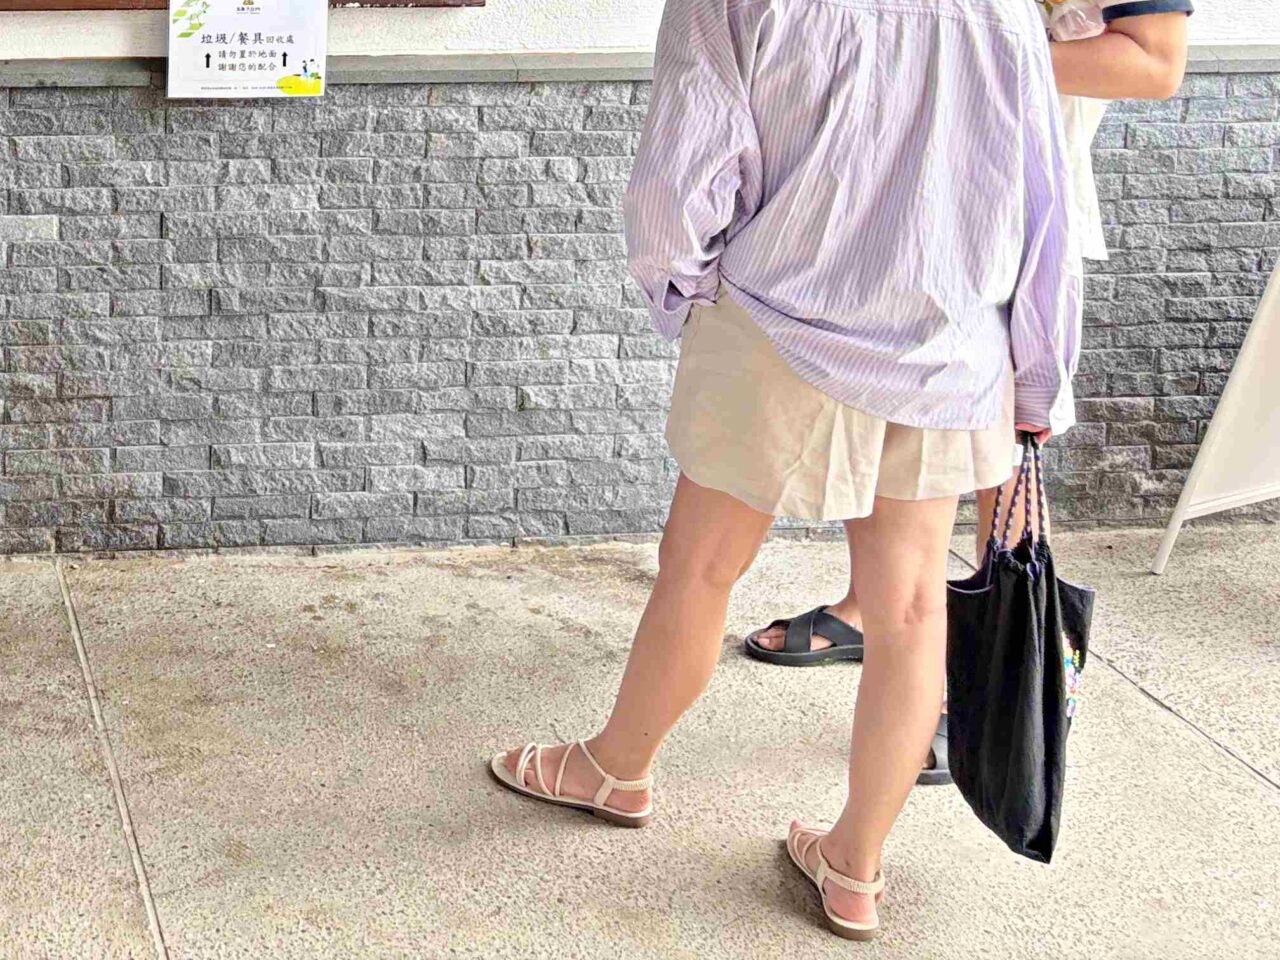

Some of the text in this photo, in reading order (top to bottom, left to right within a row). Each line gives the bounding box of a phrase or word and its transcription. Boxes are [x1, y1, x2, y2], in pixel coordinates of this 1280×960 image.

[218, 49, 278, 59] 請勿置於地面
[218, 62, 278, 72] 謝謝您的配合
